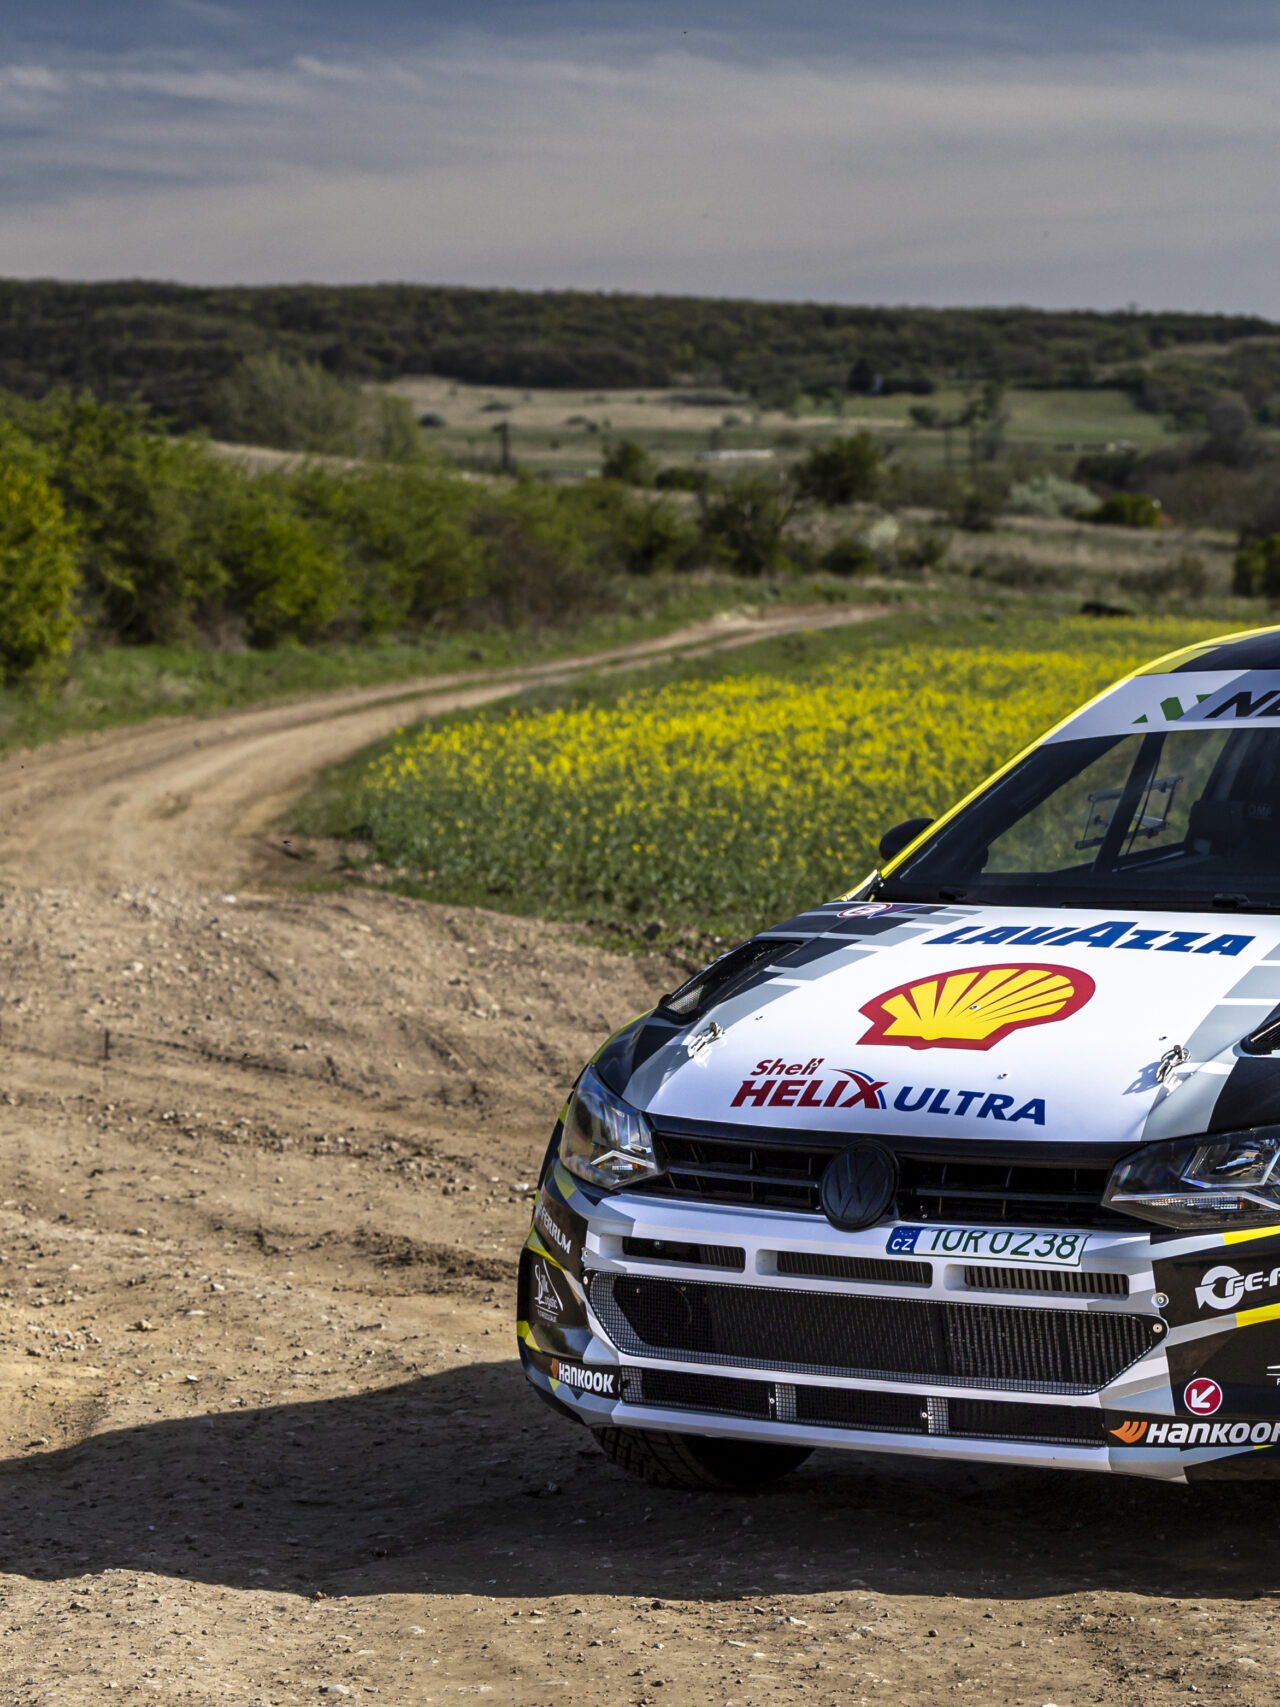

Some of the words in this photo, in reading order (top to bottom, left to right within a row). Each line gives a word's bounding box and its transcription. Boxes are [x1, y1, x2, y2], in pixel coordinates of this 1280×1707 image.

[924, 921, 1257, 956] LAVAZZA
[750, 1057, 824, 1076] Shell
[730, 1071, 889, 1109] HELIX
[893, 1086, 1046, 1126] ULTRA
[891, 1238, 914, 1251] CZ
[989, 1231, 1082, 1259] 0238
